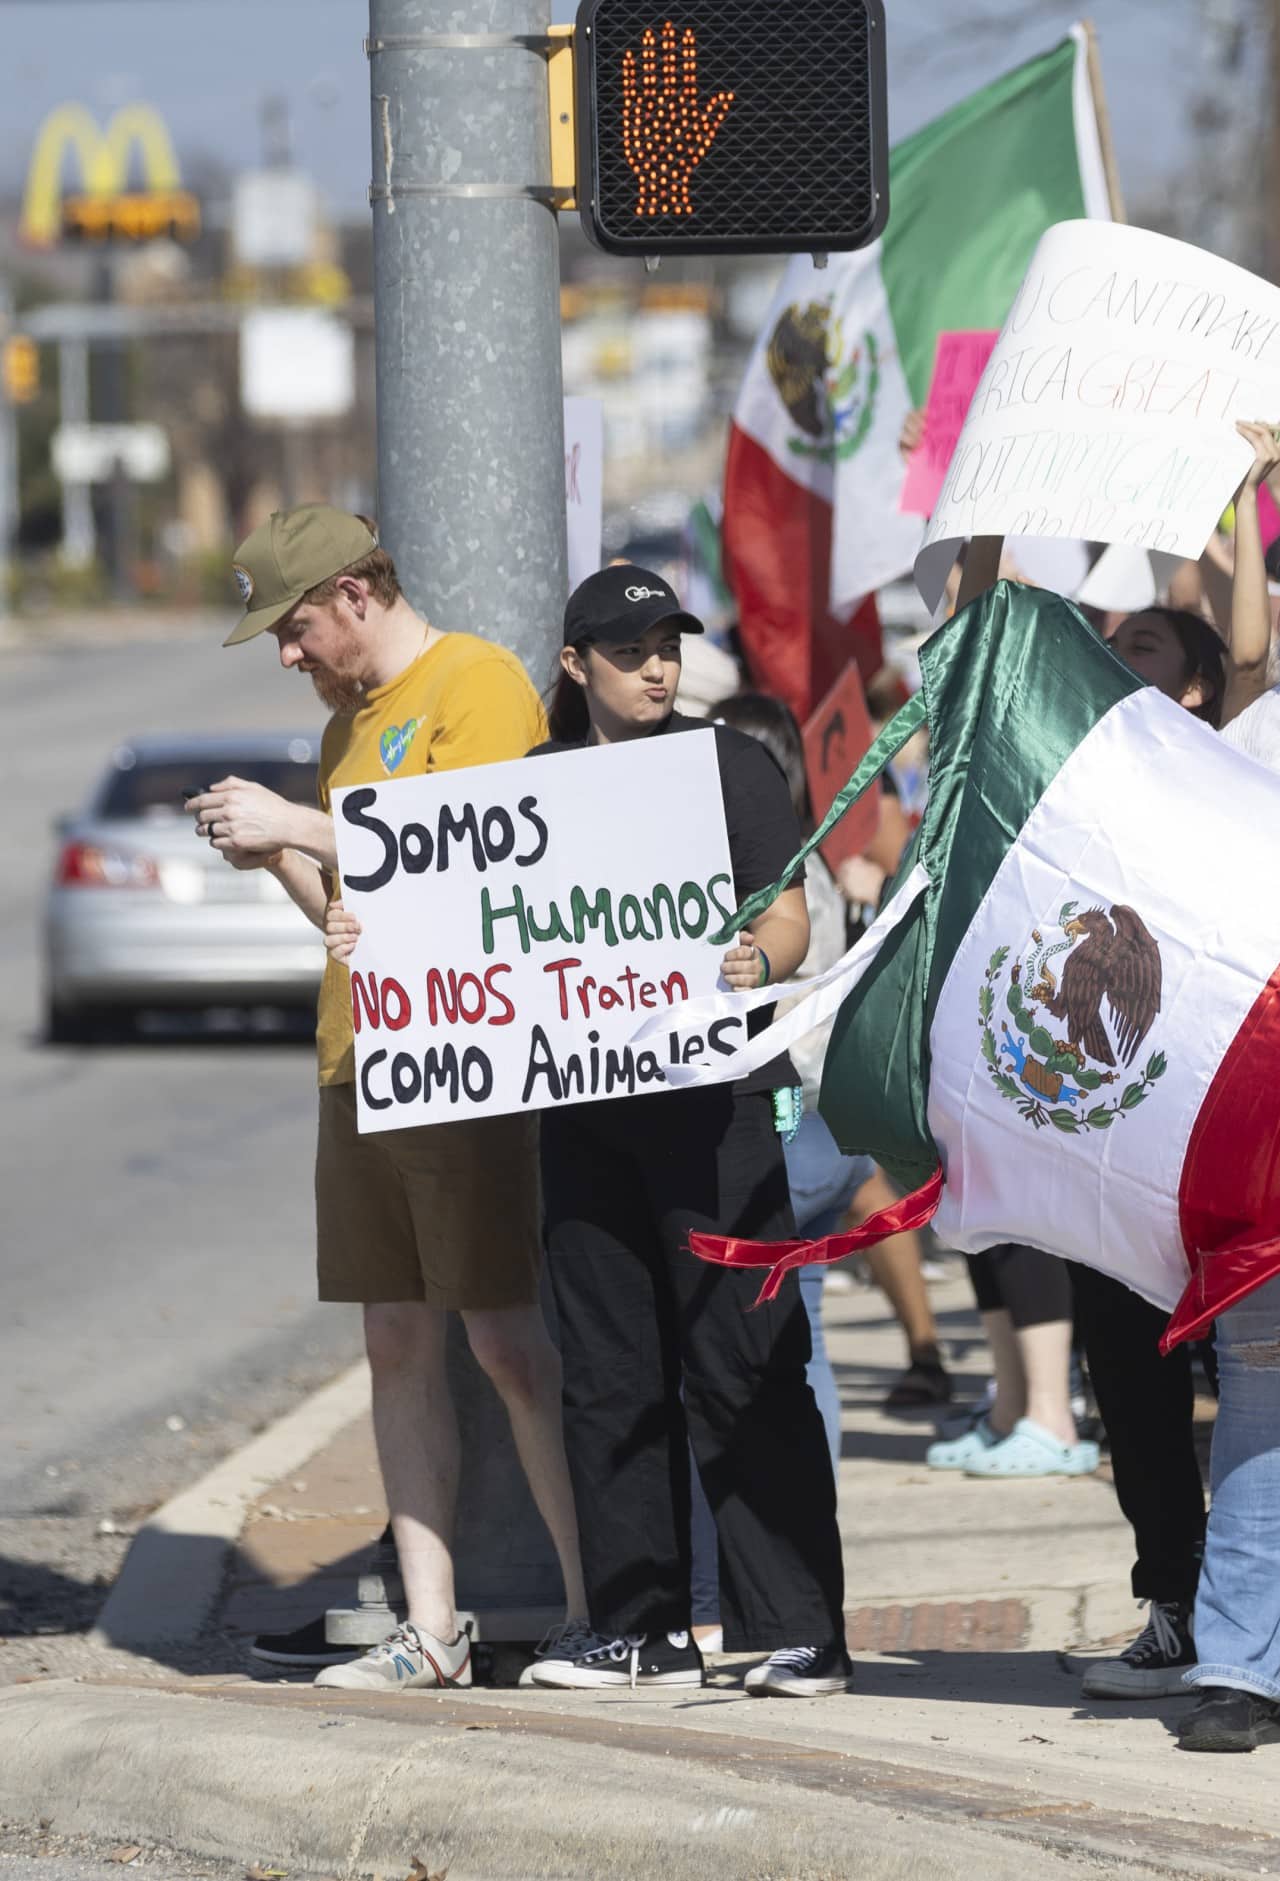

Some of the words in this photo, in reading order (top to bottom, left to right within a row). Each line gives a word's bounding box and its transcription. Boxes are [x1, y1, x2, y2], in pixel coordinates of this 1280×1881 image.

[351, 970, 412, 1034] NO
[427, 962, 516, 1027] NOS
[543, 957, 689, 1021] Traten
[360, 1041, 494, 1110] COMO
